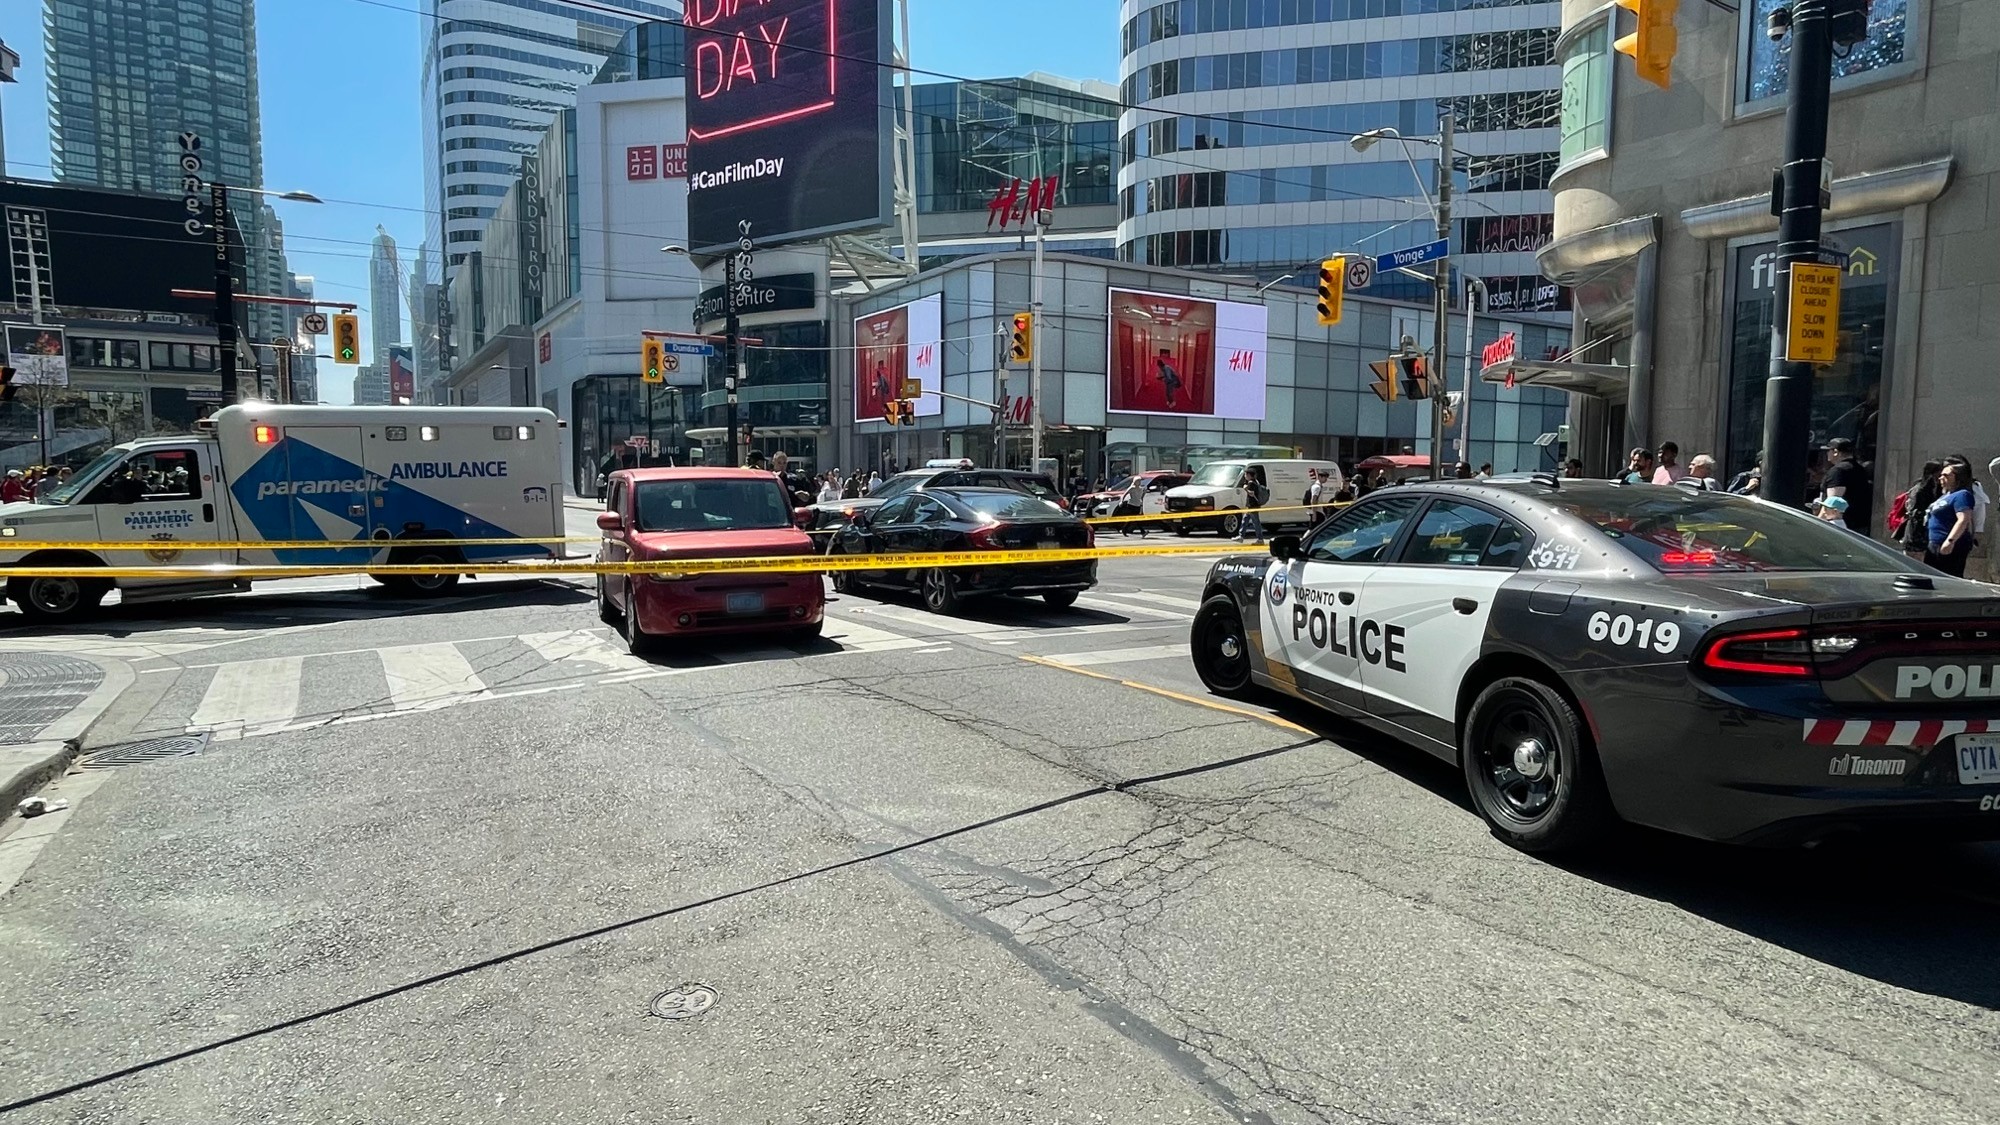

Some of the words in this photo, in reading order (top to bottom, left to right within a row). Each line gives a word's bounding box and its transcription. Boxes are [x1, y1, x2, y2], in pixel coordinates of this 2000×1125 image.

[696, 16, 789, 99] DAY
[179, 131, 204, 236] Yonge
[692, 157, 785, 190] #CanFilmDay
[987, 175, 1058, 228] H&M
[213, 188, 226, 260] DOWNTOWN
[526, 160, 541, 292] NORDSTROM
[739, 219, 753, 297] Yonge
[1393, 250, 1424, 265] Yonge
[728, 259, 736, 313] DOWNTOWN
[1797, 274, 1816, 283] CURB
[1816, 275, 1836, 284] LANE
[736, 288, 776, 307] entre
[1800, 286, 1831, 296] CLOSURE
[1803, 298, 1826, 307] AHEAD
[1802, 314, 1826, 324] SLOW
[1802, 328, 1824, 339] DOWN
[672, 344, 700, 353] Dundas
[916, 344, 933, 368] H&M
[1228, 350, 1253, 372] H&M
[390, 461, 508, 480] AMBULANCE
[257, 474, 389, 500] paramedic
[523, 495, 548, 503] 9-1-1
[124, 514, 194, 526] PARAMEDIC
[1555, 544, 1582, 554] CALL
[1238, 564, 1256, 574] Protect
[1538, 550, 1580, 570] 9-1-1
[1294, 586, 1335, 606] TORONTO
[1293, 604, 1407, 674] POLICE
[1588, 611, 1680, 654] 6019
[1851, 756, 1906, 775] TORONTO
[1961, 746, 1998, 770] CVTA
